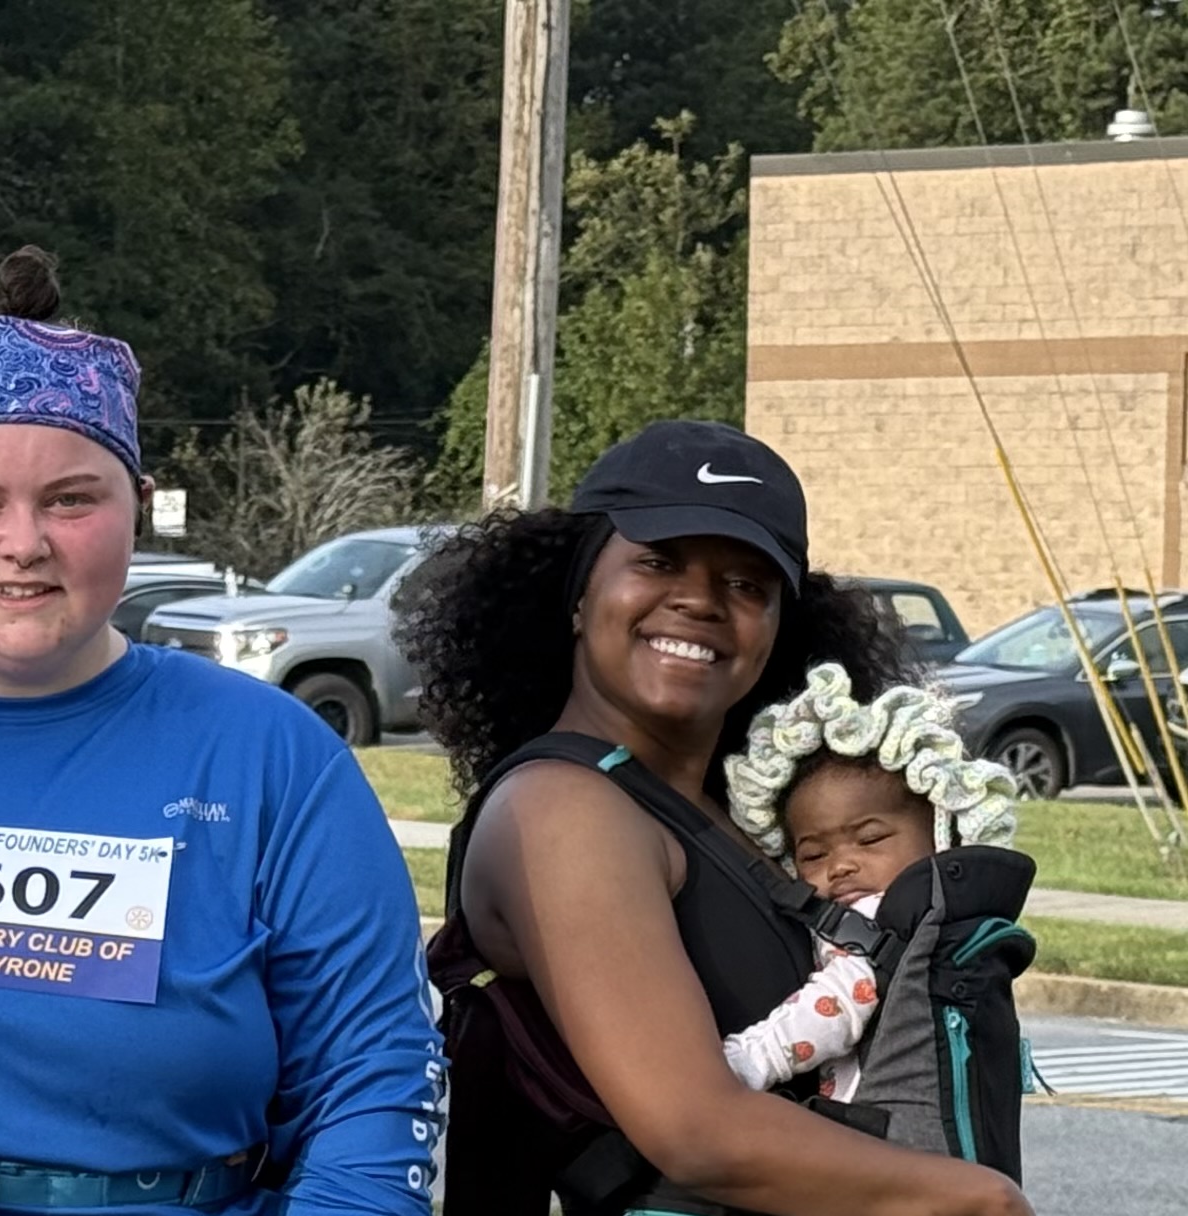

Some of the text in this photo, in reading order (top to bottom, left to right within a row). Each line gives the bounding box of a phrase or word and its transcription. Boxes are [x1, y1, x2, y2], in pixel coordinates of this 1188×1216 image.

[98, 841, 136, 862] DAY
[138, 847, 162, 864] 5K
[28, 932, 93, 958] CLUB
[99, 941, 134, 961] OF
